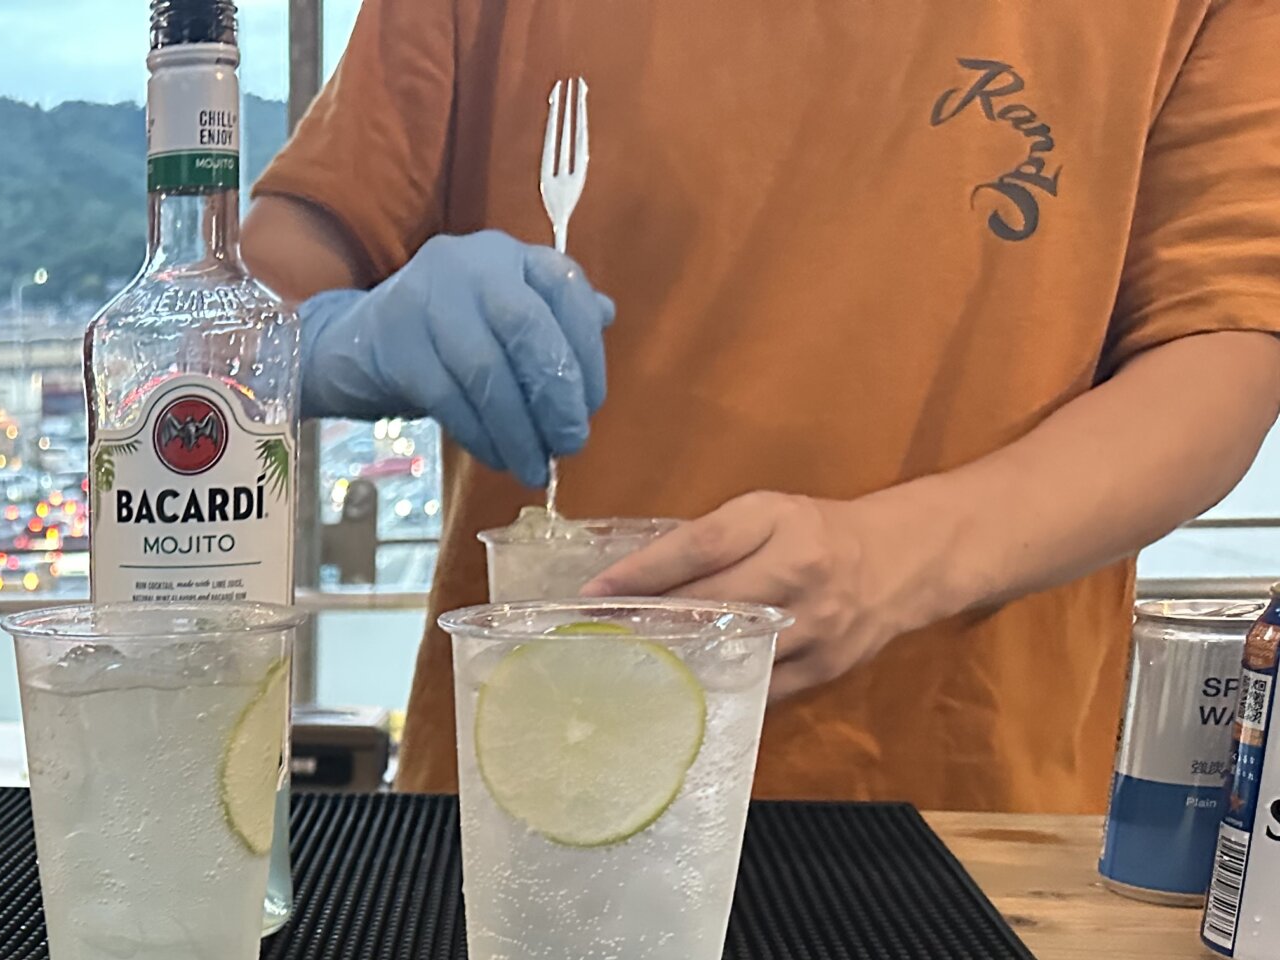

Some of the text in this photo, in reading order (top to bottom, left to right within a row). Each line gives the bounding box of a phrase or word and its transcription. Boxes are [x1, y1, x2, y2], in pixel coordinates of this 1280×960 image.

[199, 128, 233, 146] ENJOY
[116, 473, 267, 523] BACARDÍ
[143, 533, 235, 555] MOJITO
[1185, 796, 1218, 809] Plain
